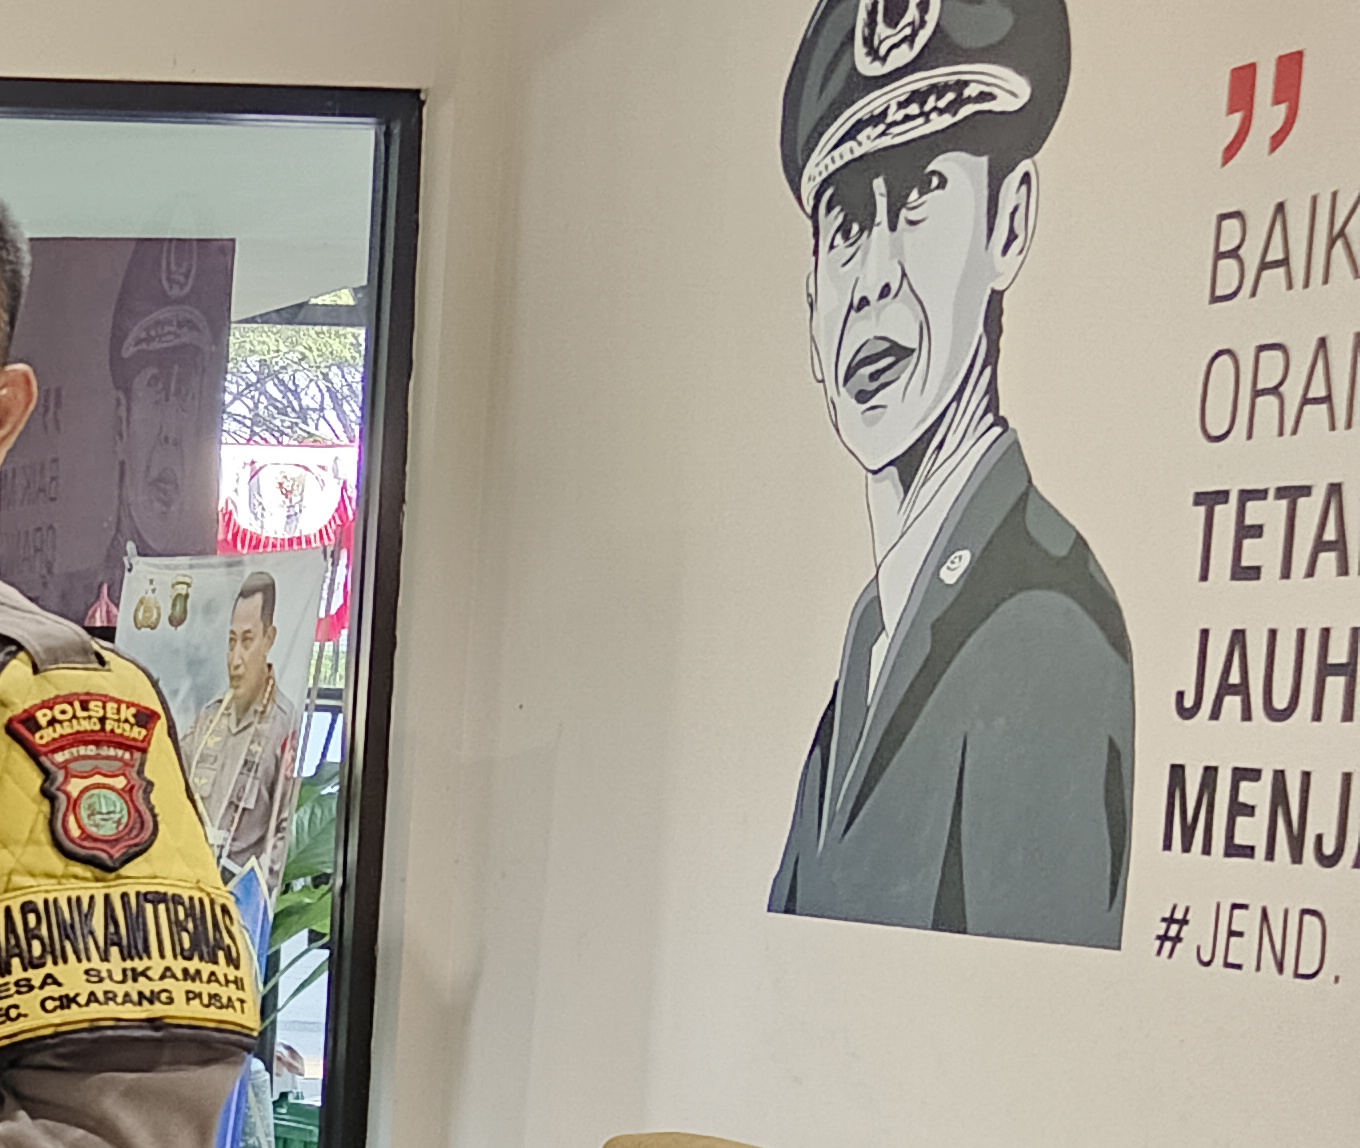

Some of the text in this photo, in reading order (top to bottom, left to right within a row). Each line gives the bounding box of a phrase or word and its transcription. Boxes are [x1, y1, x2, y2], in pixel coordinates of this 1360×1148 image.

[1209, 189, 1360, 304] BAIK
[1192, 481, 1360, 582] TETA
[35, 700, 137, 728] POLSEK
[1176, 627, 1360, 722] JAUH
[1162, 763, 1360, 869] MENJ
[40, 989, 174, 1014] CIKARANG
[185, 989, 246, 1014] PUSAT
[83, 966, 245, 992] SUKAMAHI
